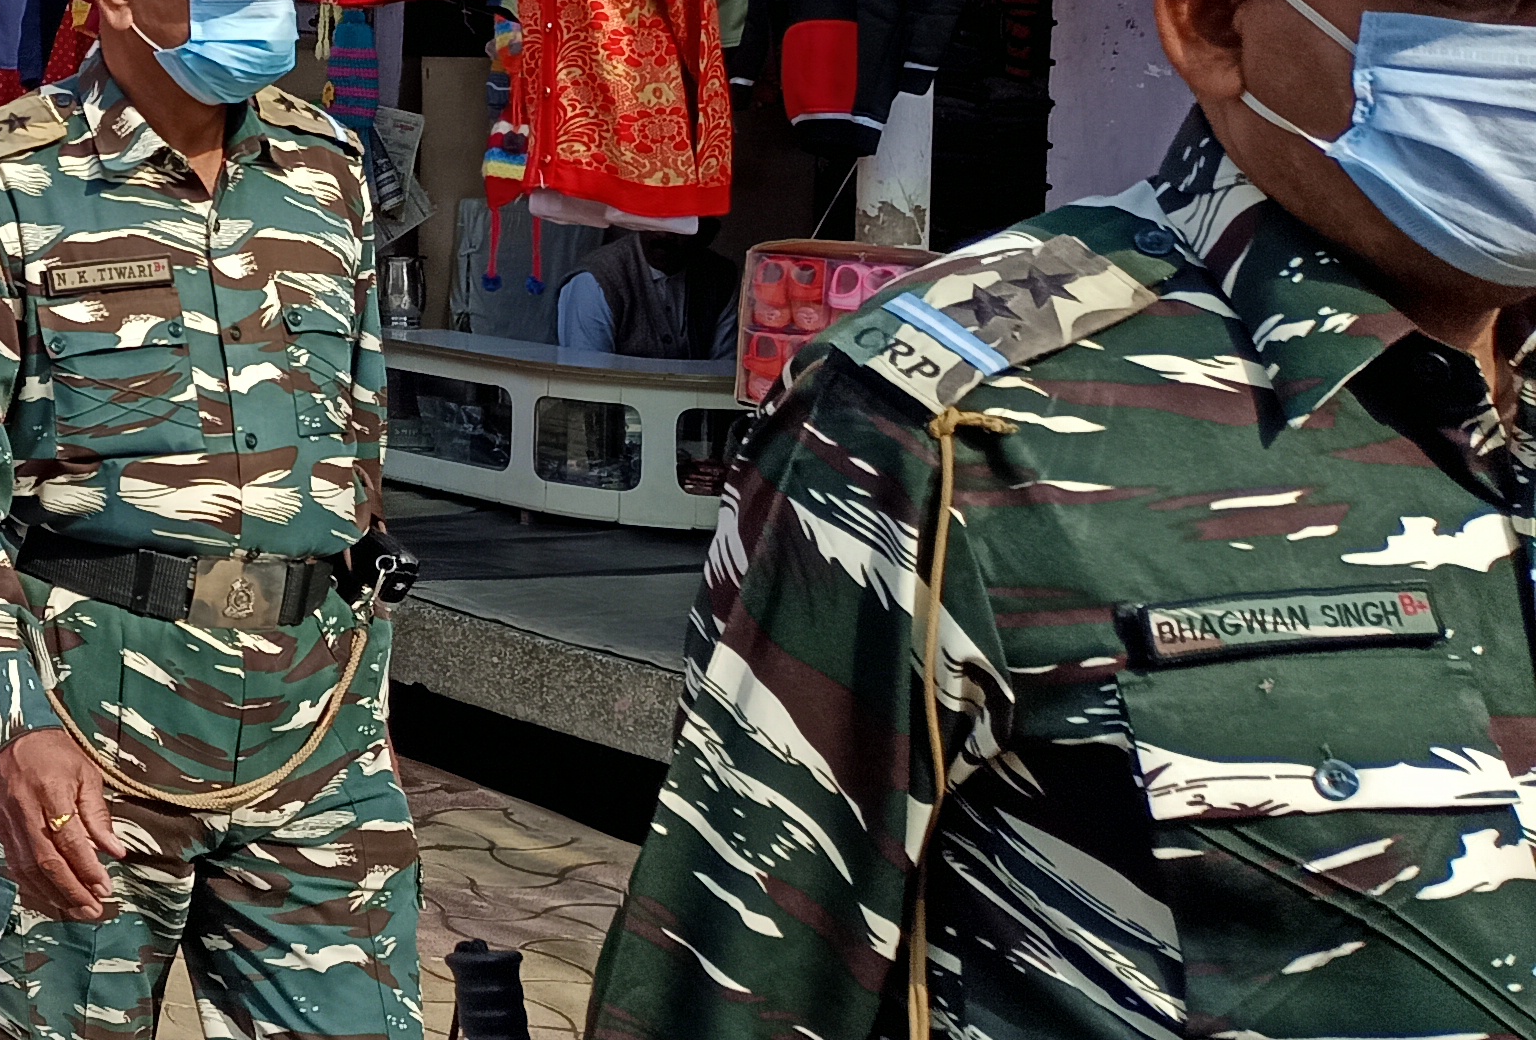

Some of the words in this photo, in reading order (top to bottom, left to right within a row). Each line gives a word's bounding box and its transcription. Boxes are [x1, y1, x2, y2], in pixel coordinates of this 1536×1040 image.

[854, 326, 941, 379] CRP
[1155, 604, 1311, 645] BHAGWAN
[1320, 600, 1404, 628] SINGH
[1398, 591, 1429, 617] B+
